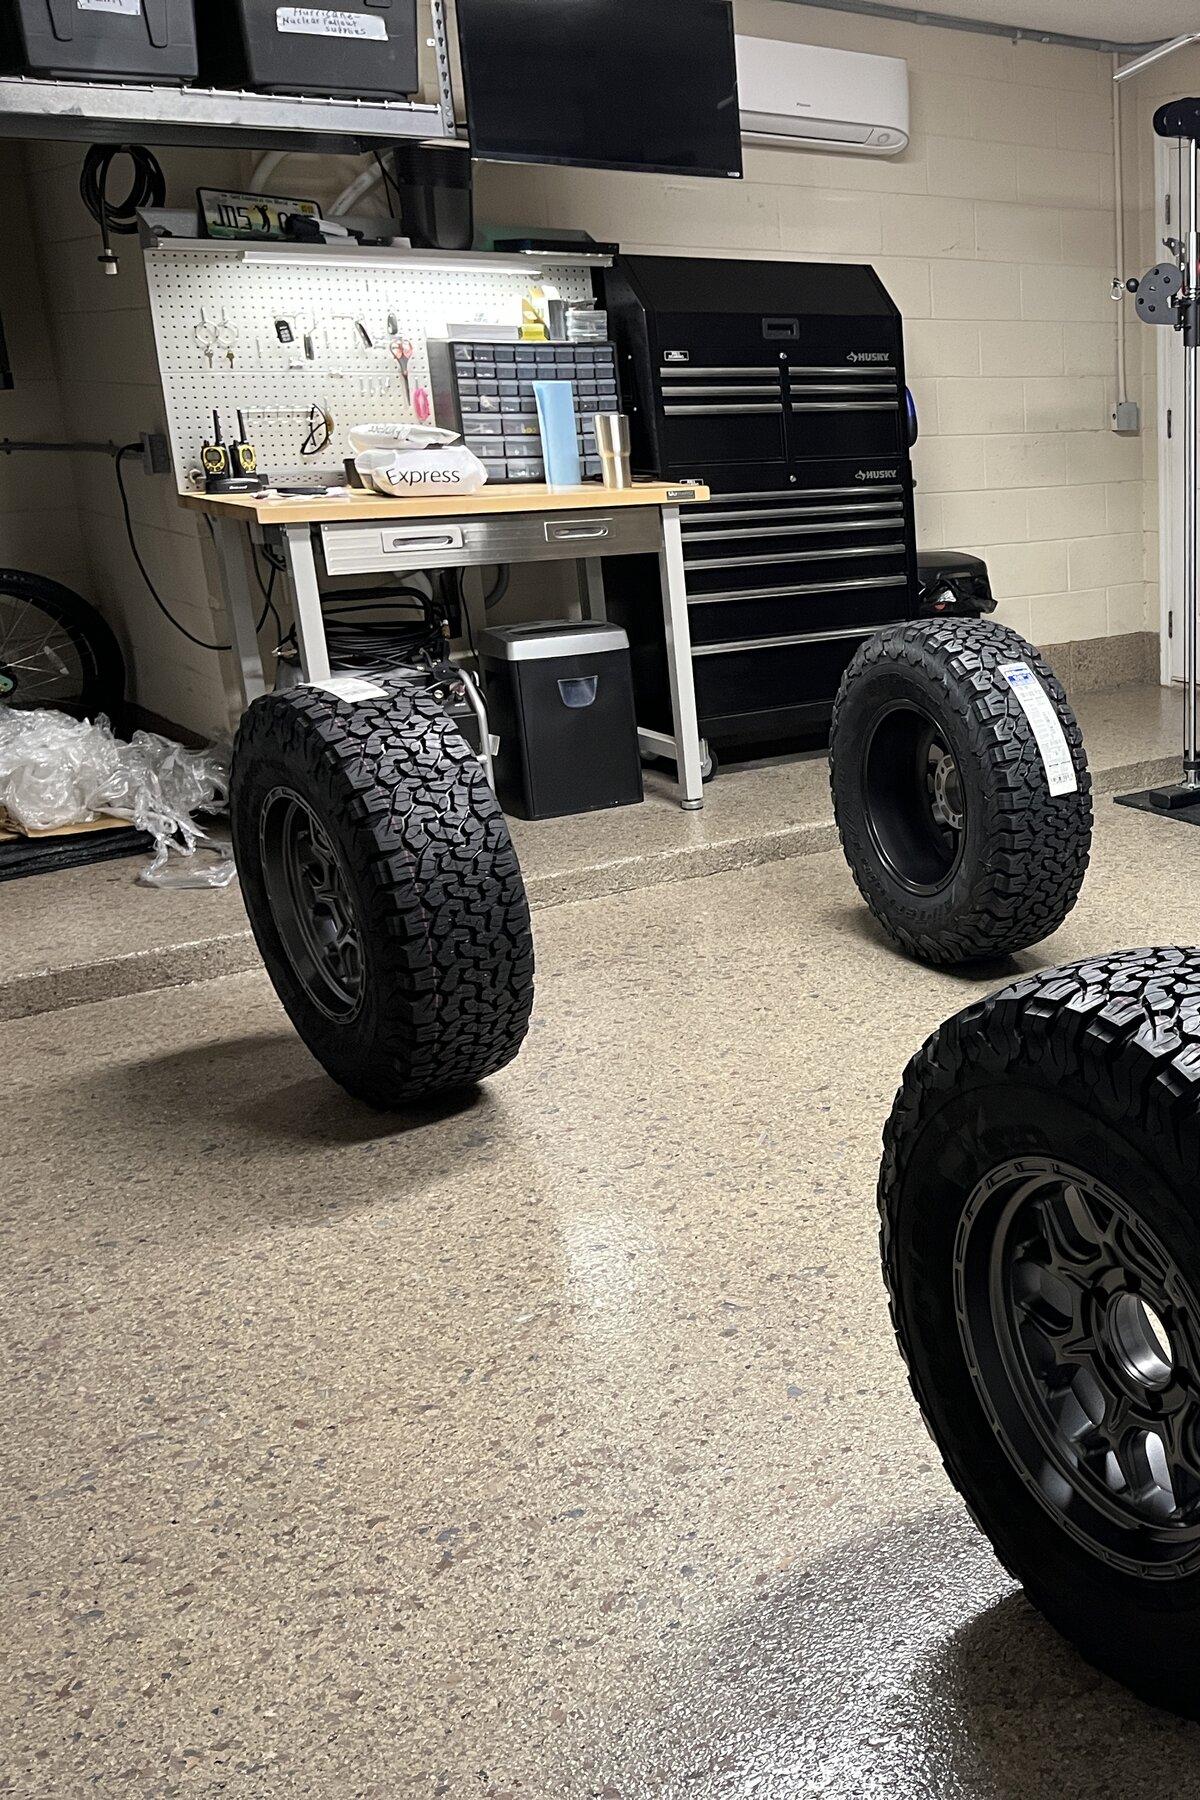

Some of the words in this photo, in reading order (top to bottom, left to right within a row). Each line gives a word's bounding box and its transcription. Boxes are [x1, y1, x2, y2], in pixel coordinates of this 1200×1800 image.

[857, 352, 890, 362] HUSKY
[385, 467, 461, 486] Express
[866, 469, 898, 480] HUSKY
